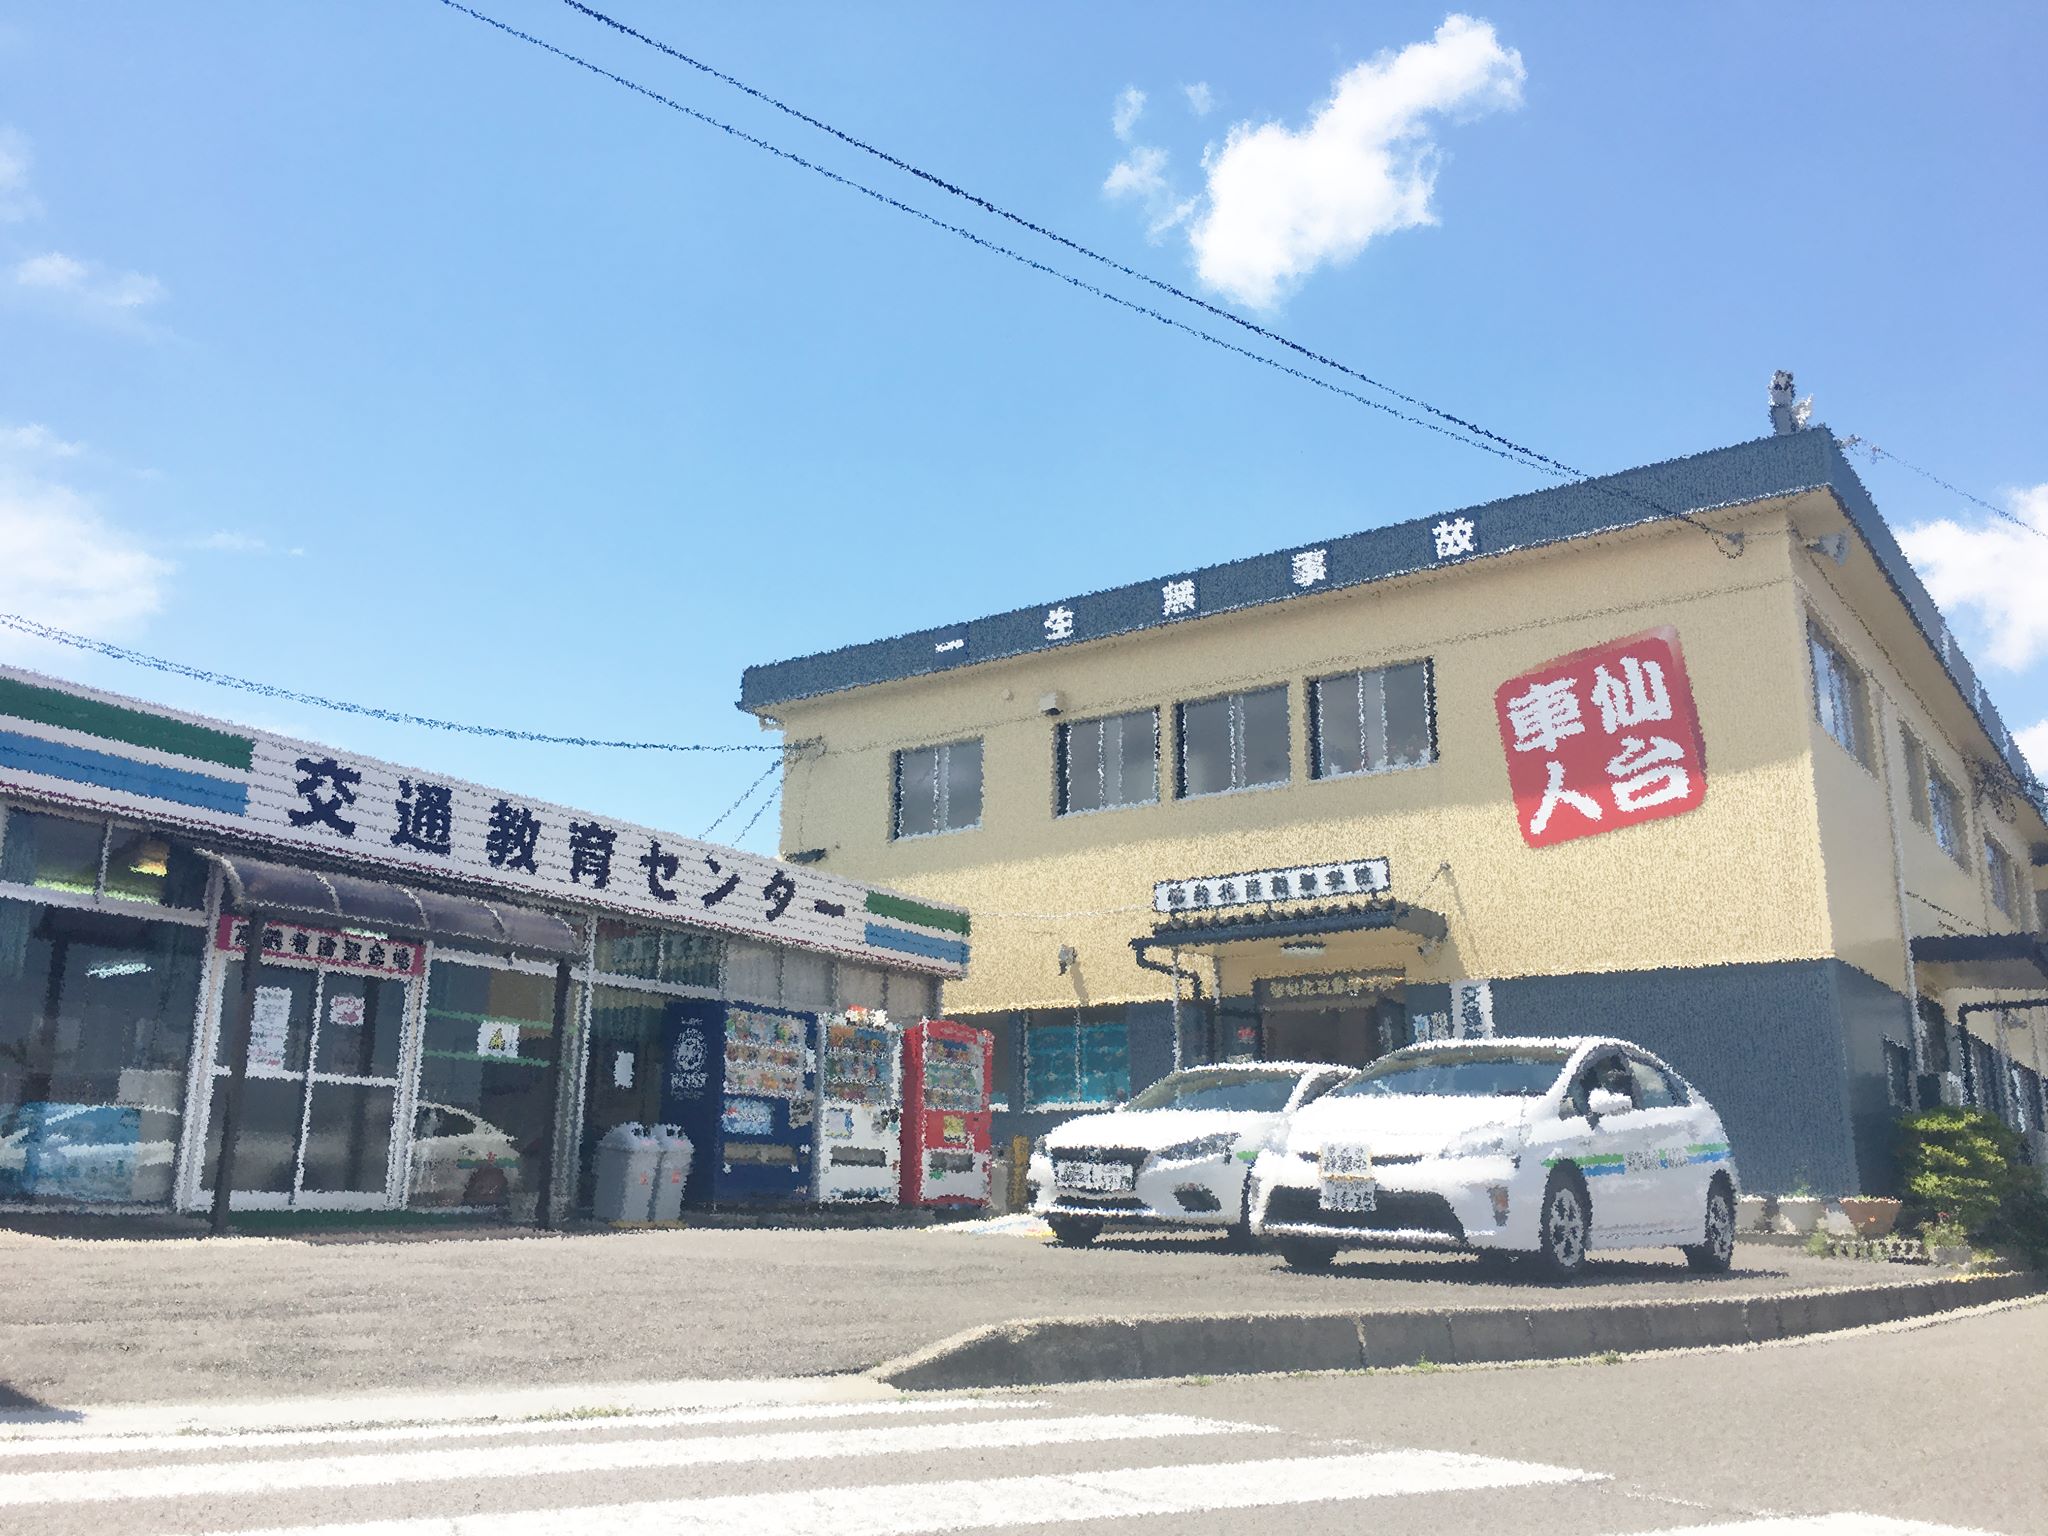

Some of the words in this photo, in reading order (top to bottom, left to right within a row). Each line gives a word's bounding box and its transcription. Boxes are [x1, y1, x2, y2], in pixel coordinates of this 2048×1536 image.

[1507, 677, 1603, 835] 車人
[1591, 656, 1692, 812] 仙台
[288, 757, 846, 922] 交通教育センター
